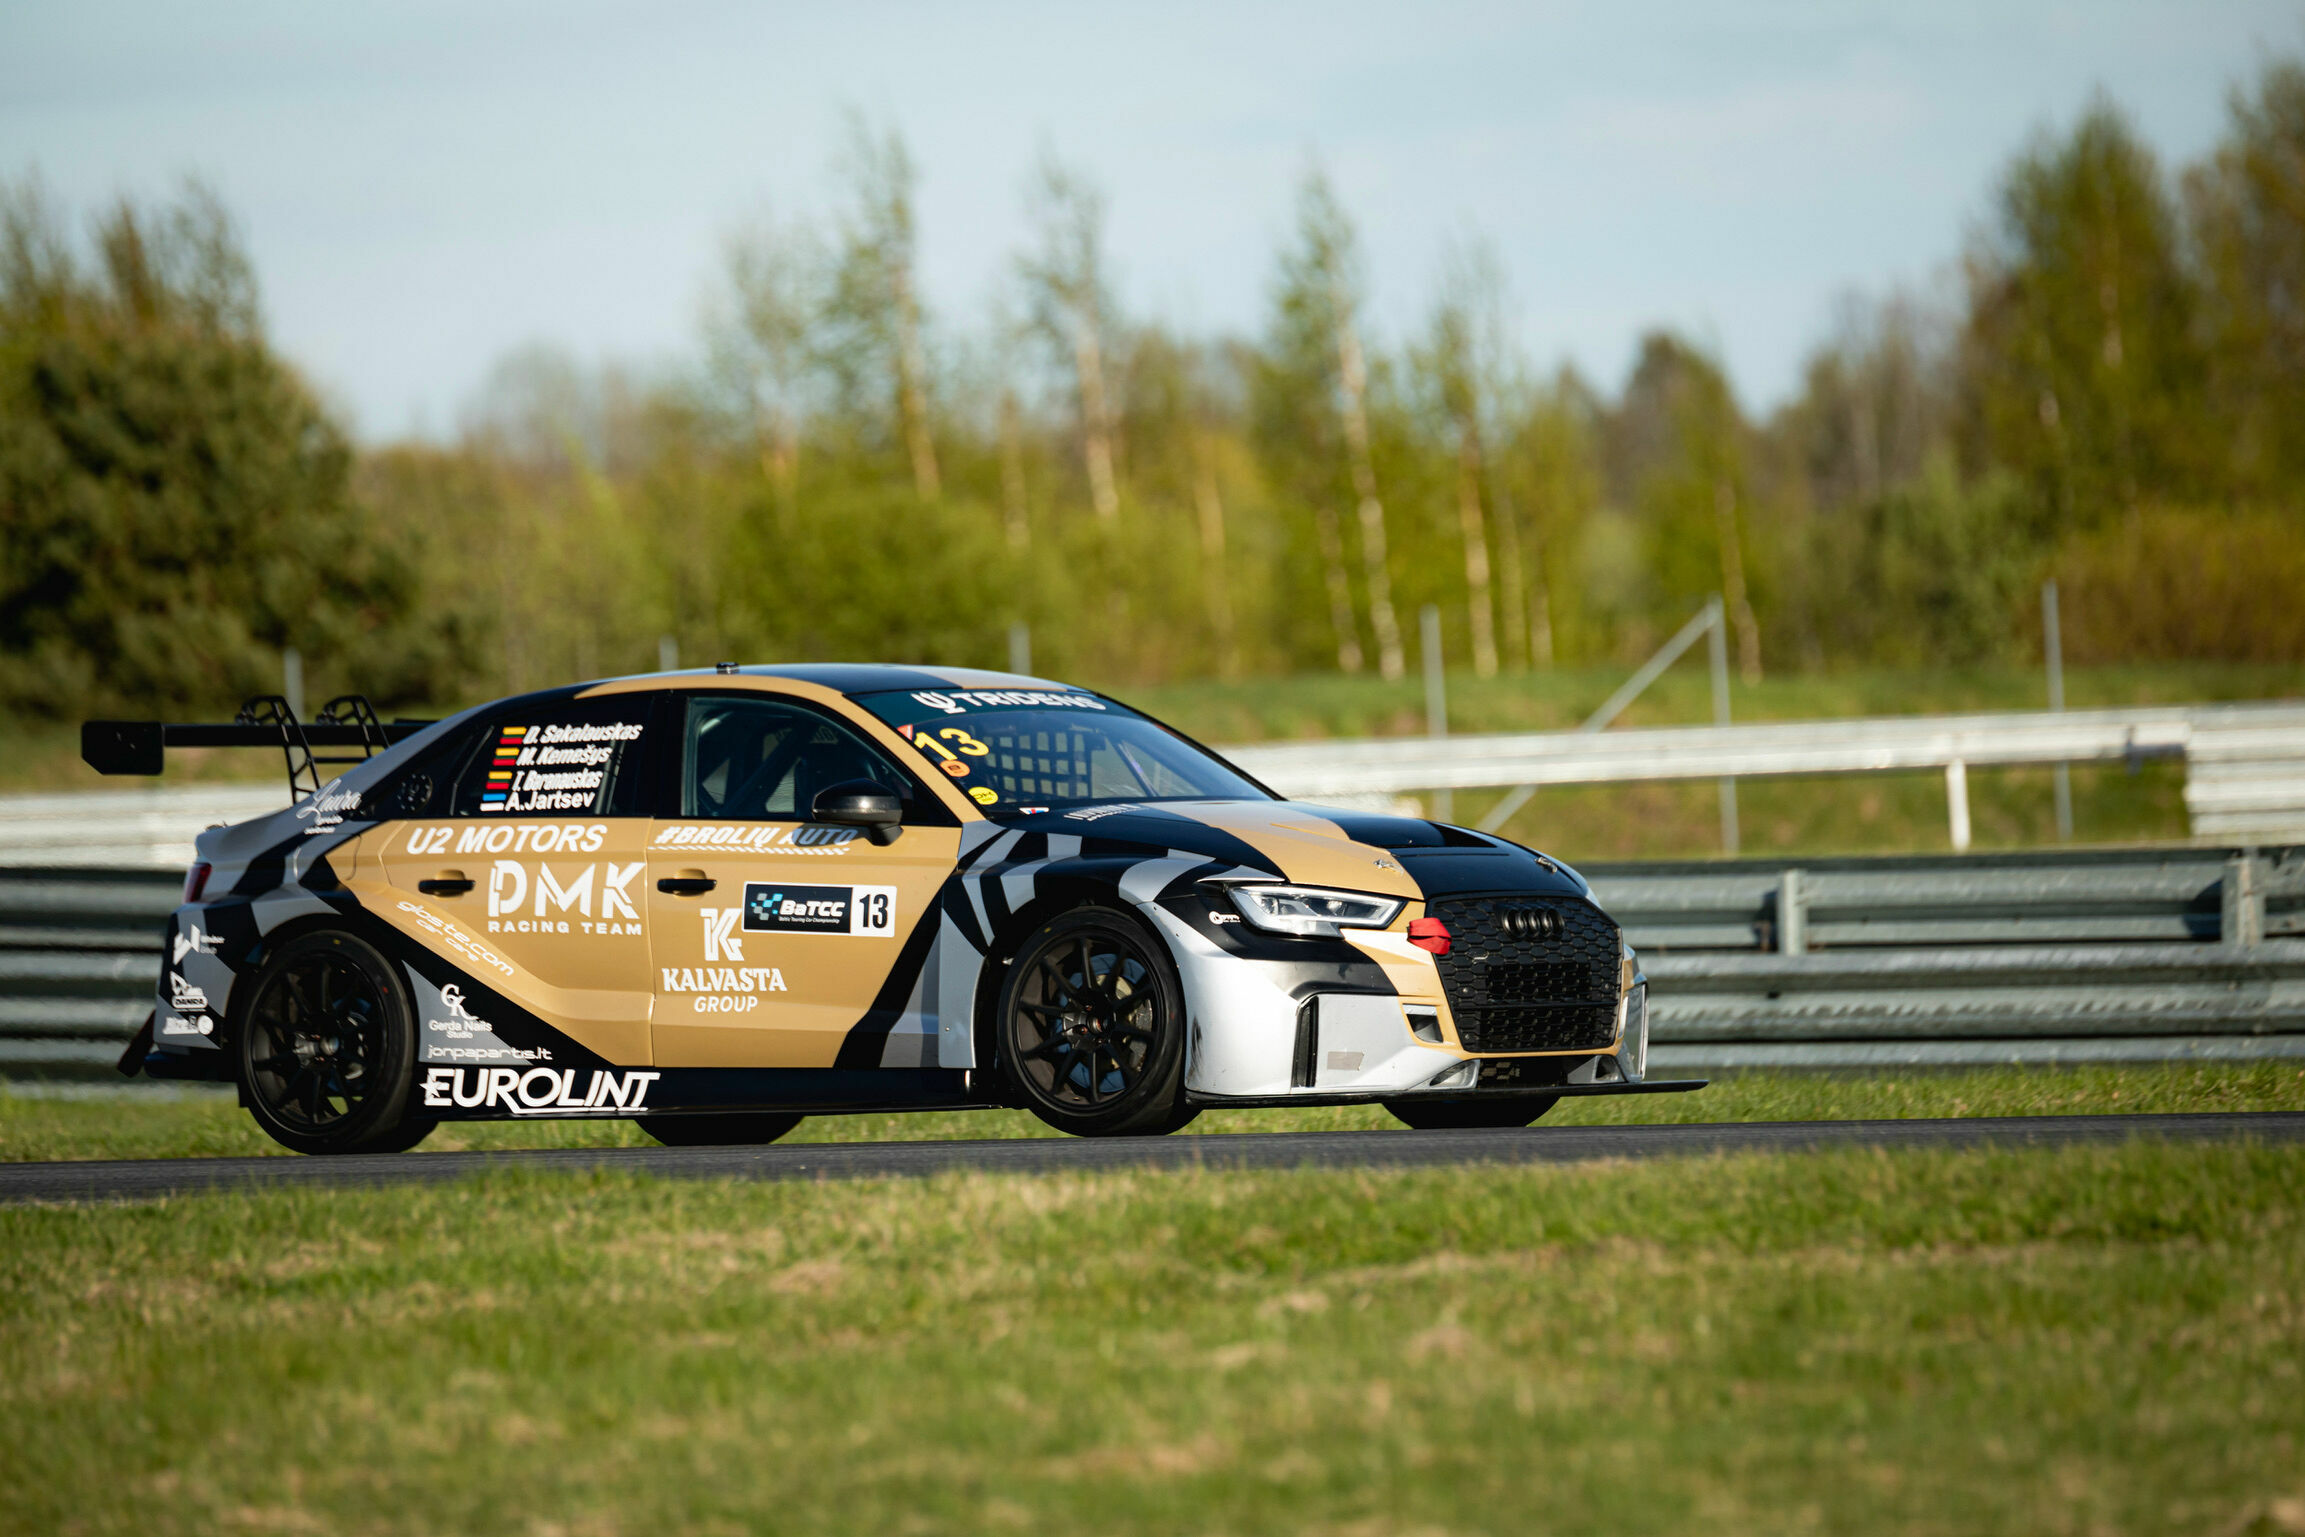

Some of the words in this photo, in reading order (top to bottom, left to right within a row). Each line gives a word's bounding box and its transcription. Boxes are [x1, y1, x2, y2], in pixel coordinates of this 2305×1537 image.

[953, 692, 1106, 710] TRIDENS
[540, 721, 643, 743] Sakalauskas
[516, 747, 538, 766] M.
[537, 744, 613, 766] Kemešys
[914, 728, 989, 761] 13
[406, 827, 453, 855] U2
[456, 824, 607, 853] MOTORS
[655, 826, 780, 848] #BROLIŲ
[778, 828, 857, 846] AUTO
[488, 860, 646, 919] DMK
[779, 900, 846, 917] BaTCC
[859, 894, 889, 929] 13
[416, 919, 443, 935] car
[488, 921, 569, 933] RACING
[581, 922, 642, 935] TEAM
[396, 901, 514, 976] gloste.com
[662, 968, 787, 992] KALVASTA
[694, 996, 758, 1012] GROUP
[428, 1020, 463, 1031] Gerda
[463, 1020, 493, 1032] Nails
[446, 1030, 474, 1039] Studio
[422, 1067, 661, 1114] EUROLINT
